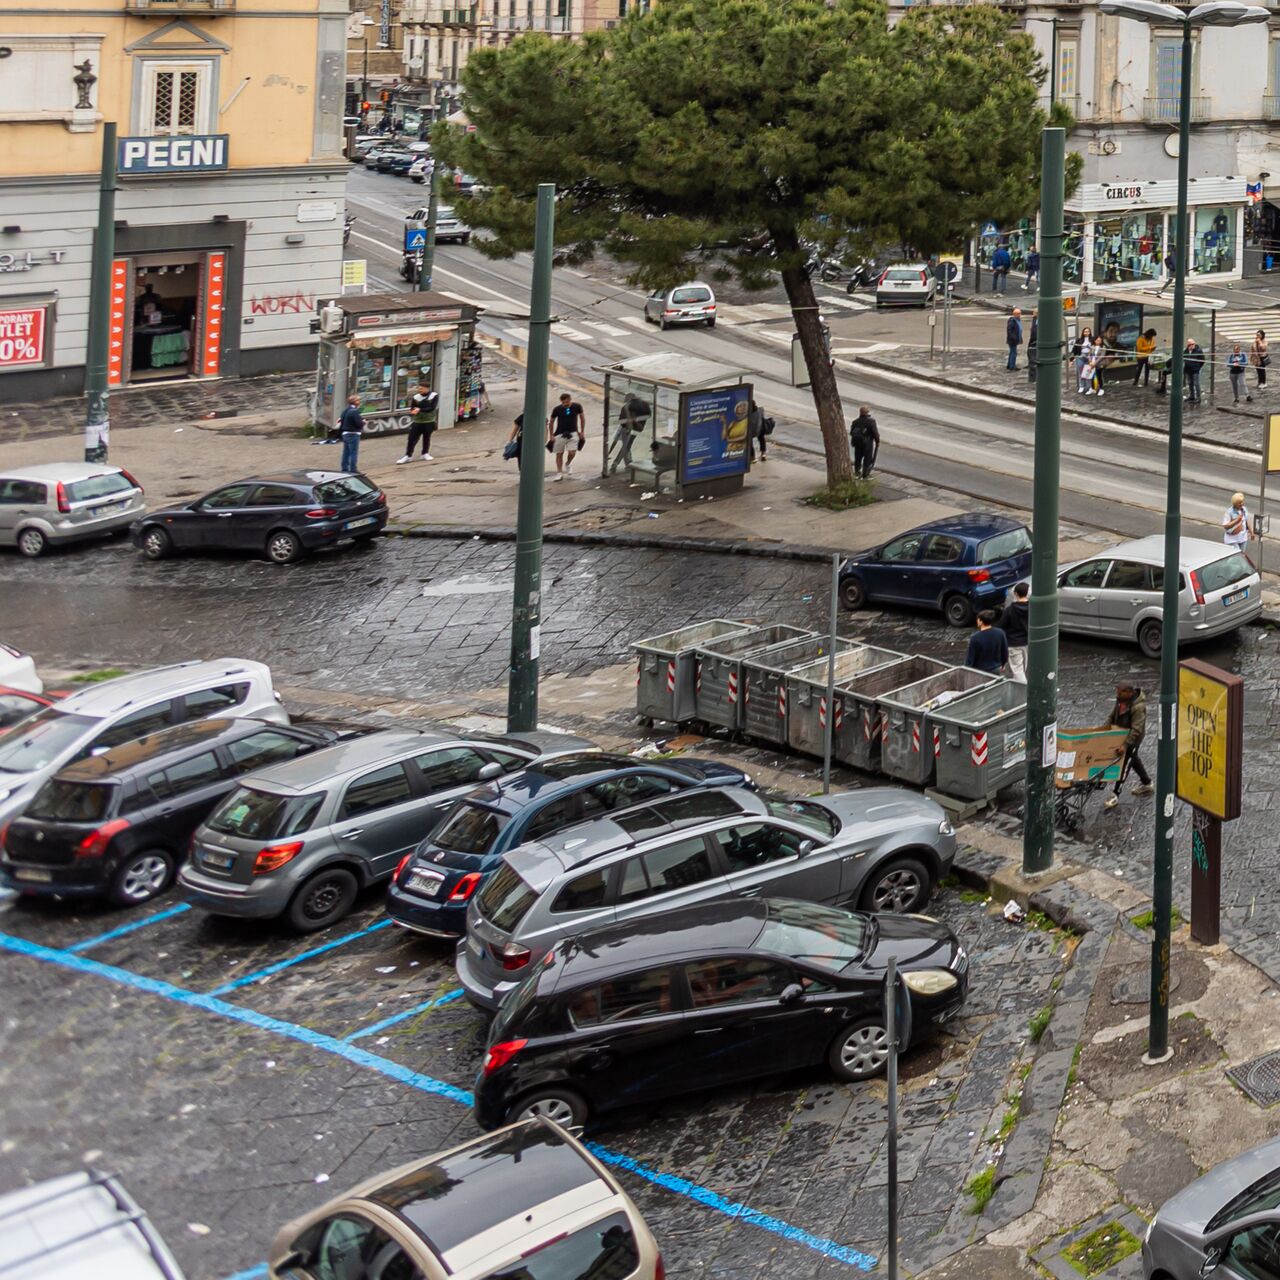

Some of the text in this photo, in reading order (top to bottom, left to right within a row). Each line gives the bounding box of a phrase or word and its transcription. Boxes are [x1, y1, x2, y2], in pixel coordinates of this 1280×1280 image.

[124, 139, 224, 168] PEGNI
[1106, 186, 1142, 200] CIRCUS
[0, 339, 36, 361] 0%
[1188, 704, 1217, 735] OPEN
[1191, 726, 1213, 758] THE
[1191, 750, 1213, 779] TOP
